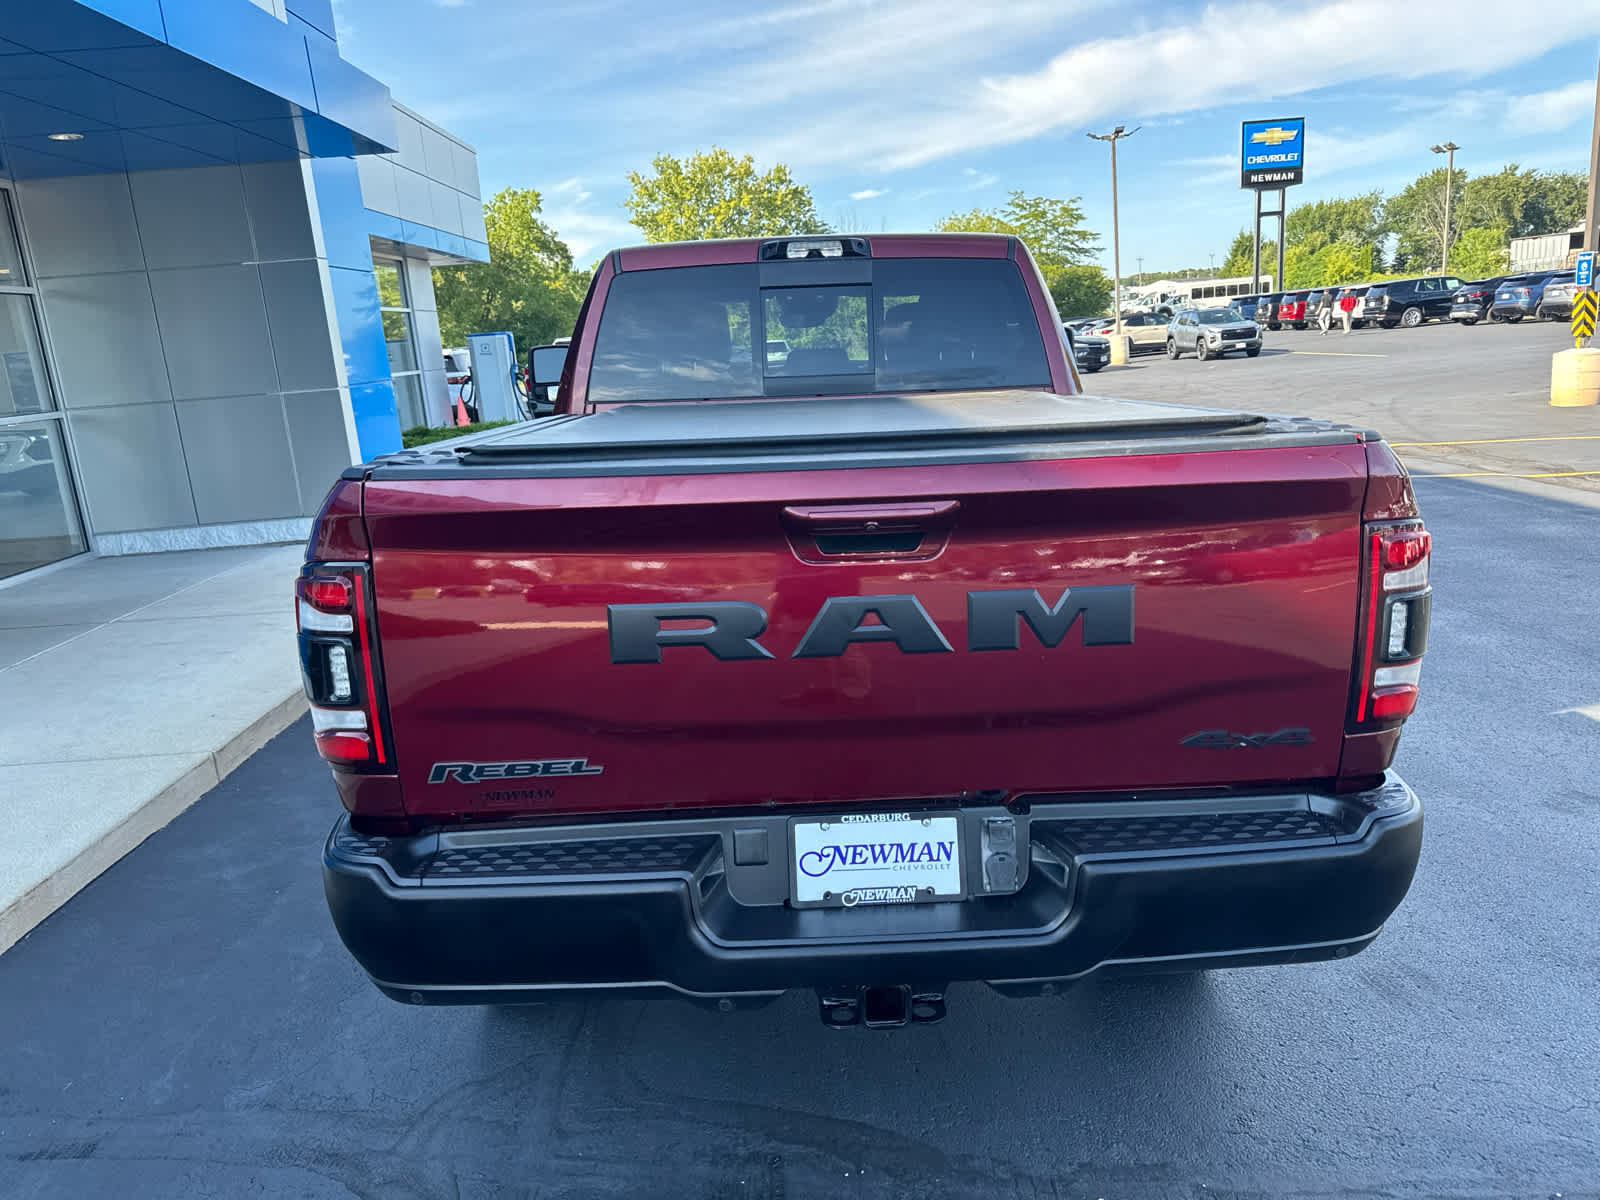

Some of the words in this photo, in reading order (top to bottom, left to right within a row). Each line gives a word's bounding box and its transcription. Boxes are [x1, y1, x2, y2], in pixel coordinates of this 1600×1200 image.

[1247, 153, 1298, 164] CHEVROLET
[1251, 172, 1294, 183] NEWMAN
[607, 585, 1135, 664] RAM
[427, 757, 603, 784] REBEL
[481, 789, 554, 801] NEWMAN
[841, 813, 911, 824] CEDARBURG
[799, 842, 955, 877] NEWMAN
[892, 863, 951, 872] CHEVROLET
[842, 887, 916, 906] NEWMAN
